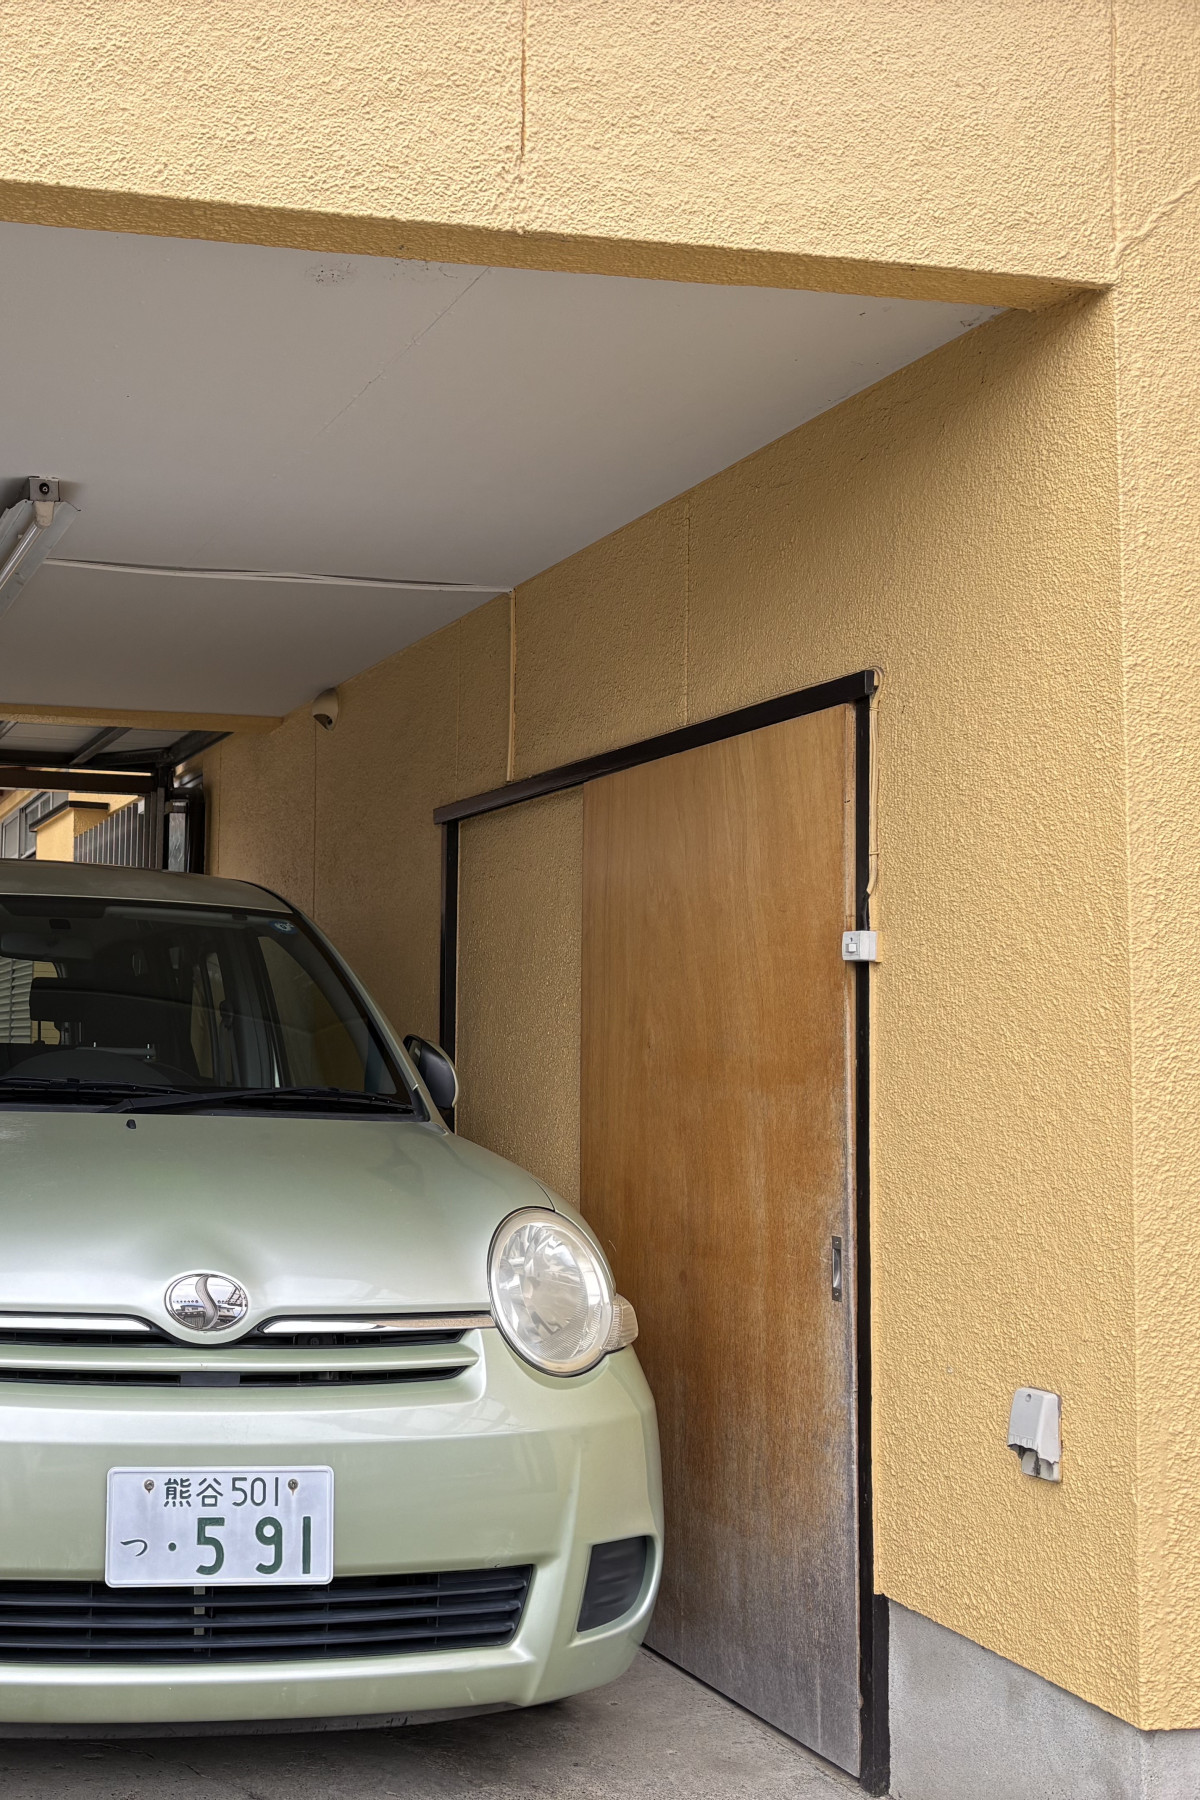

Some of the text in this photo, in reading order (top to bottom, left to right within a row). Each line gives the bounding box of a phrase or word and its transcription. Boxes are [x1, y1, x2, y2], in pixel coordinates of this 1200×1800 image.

[163, 1476, 279, 1508] 熊谷 501
[119, 1538, 148, 1557] つ
